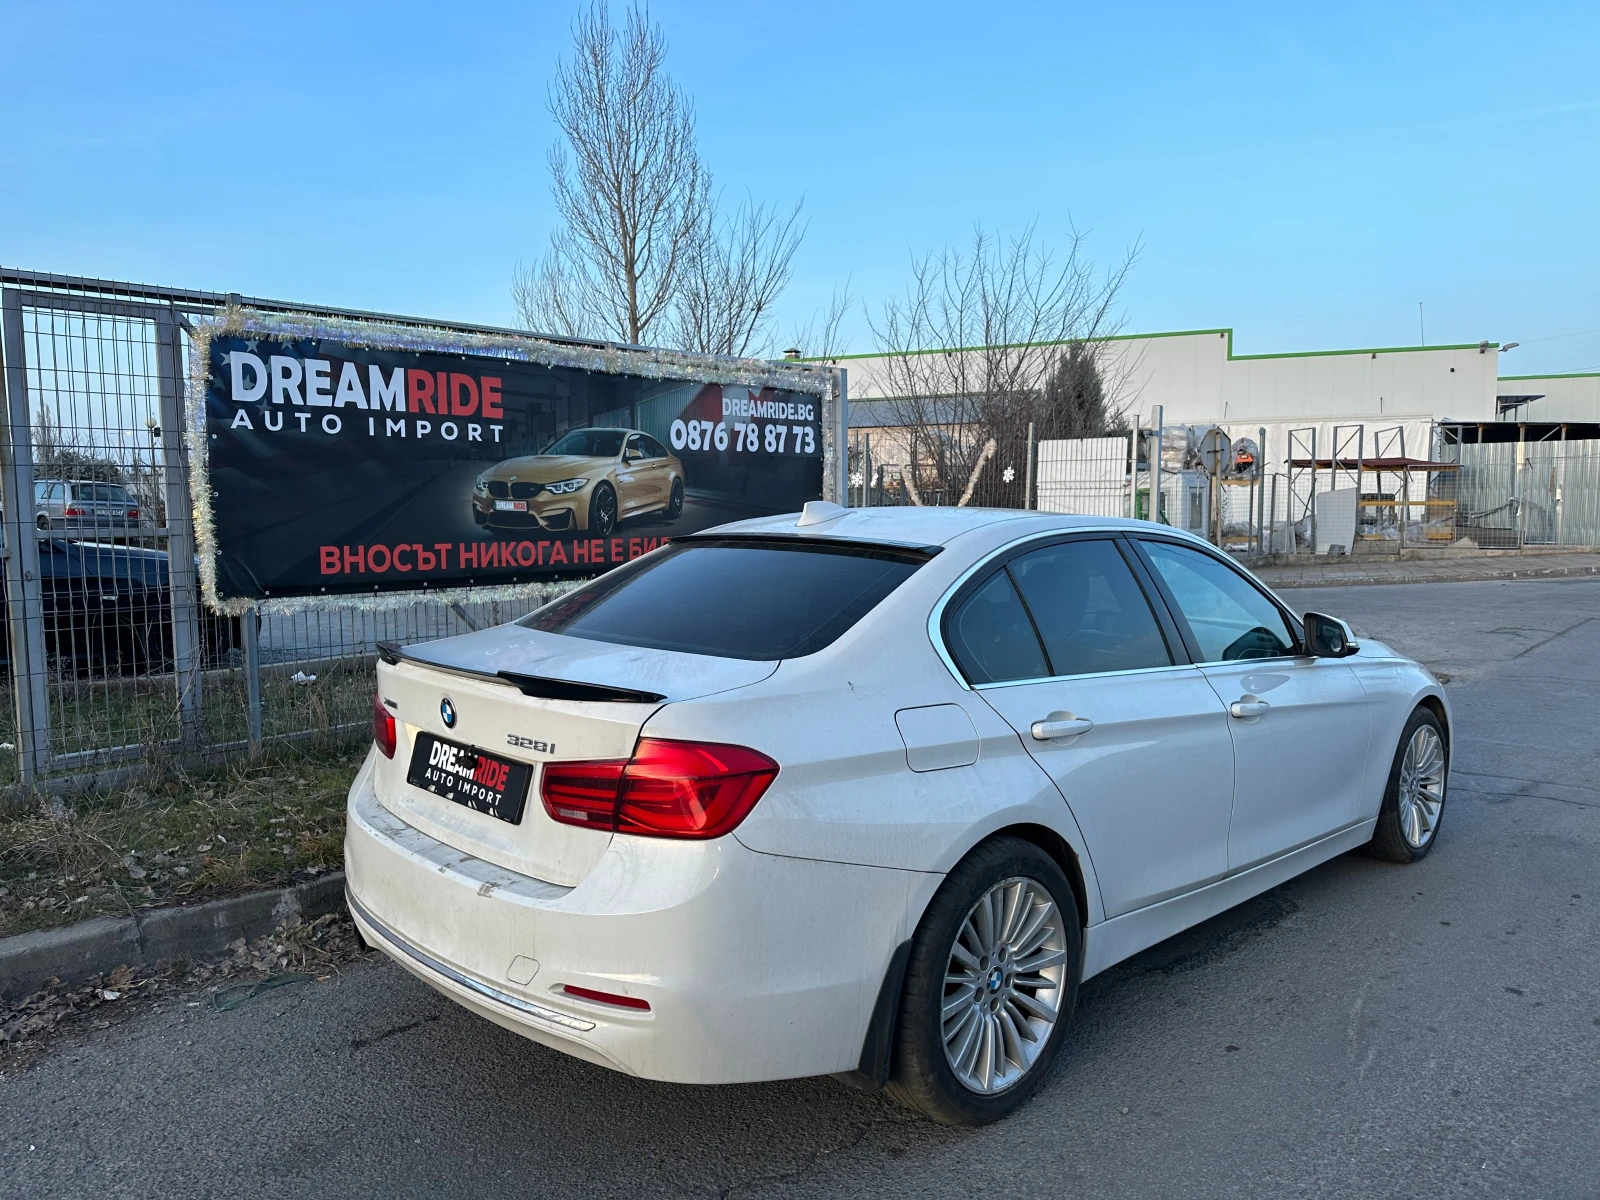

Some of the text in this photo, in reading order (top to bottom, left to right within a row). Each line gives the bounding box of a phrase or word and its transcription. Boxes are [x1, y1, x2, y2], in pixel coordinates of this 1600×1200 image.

[230, 351, 504, 419] DREAMRIDE
[230, 409, 503, 443] AUTO IMPORT
[722, 398, 814, 421] DREAMRIDE.BG
[670, 419, 815, 453] 0876 78 87 73
[496, 501, 526, 510] DREAMRIDE
[320, 543, 452, 575] ВНОСЪТ
[459, 540, 568, 569] НИКОГА
[573, 539, 604, 563] НЕ
[611, 538, 623, 561] Е
[425, 767, 502, 805] AUTO IMPORT
